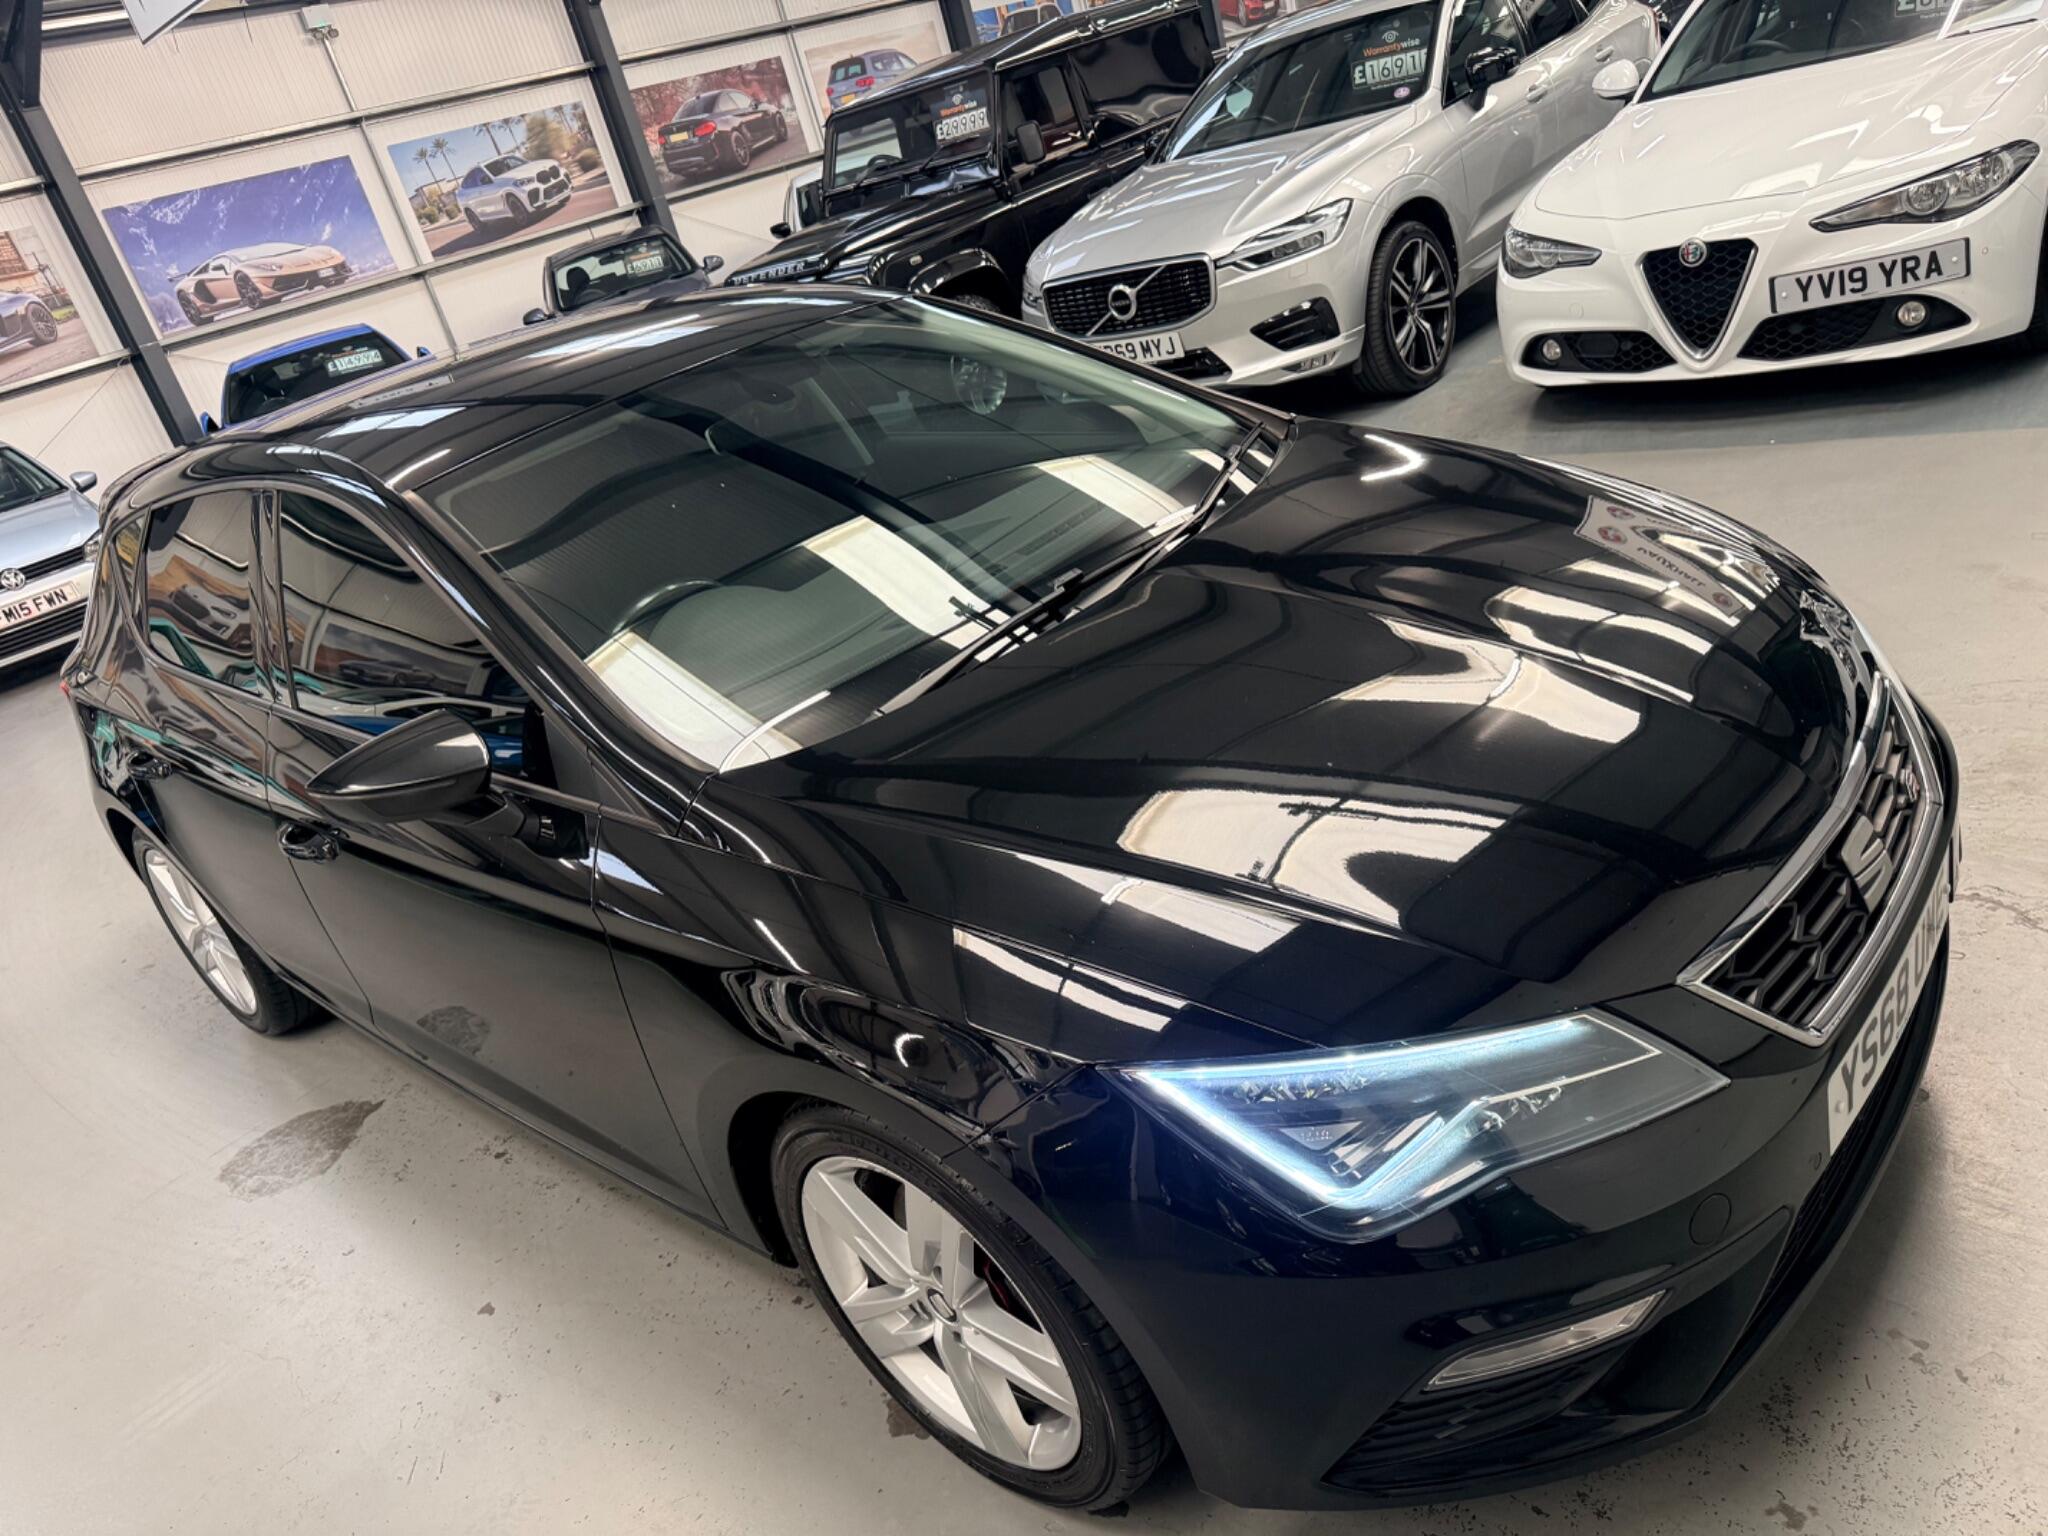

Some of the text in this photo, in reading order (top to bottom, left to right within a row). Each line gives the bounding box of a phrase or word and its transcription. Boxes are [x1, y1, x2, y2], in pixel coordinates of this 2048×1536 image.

[1363, 38, 1420, 57] Warrantywise
[936, 110, 985, 139] £29999
[1796, 251, 1943, 302] YV19 YRA
[1139, 336, 1176, 359] MYJ
[0, 588, 68, 623] M15 FWN
[1841, 957, 1909, 1113] YS68
